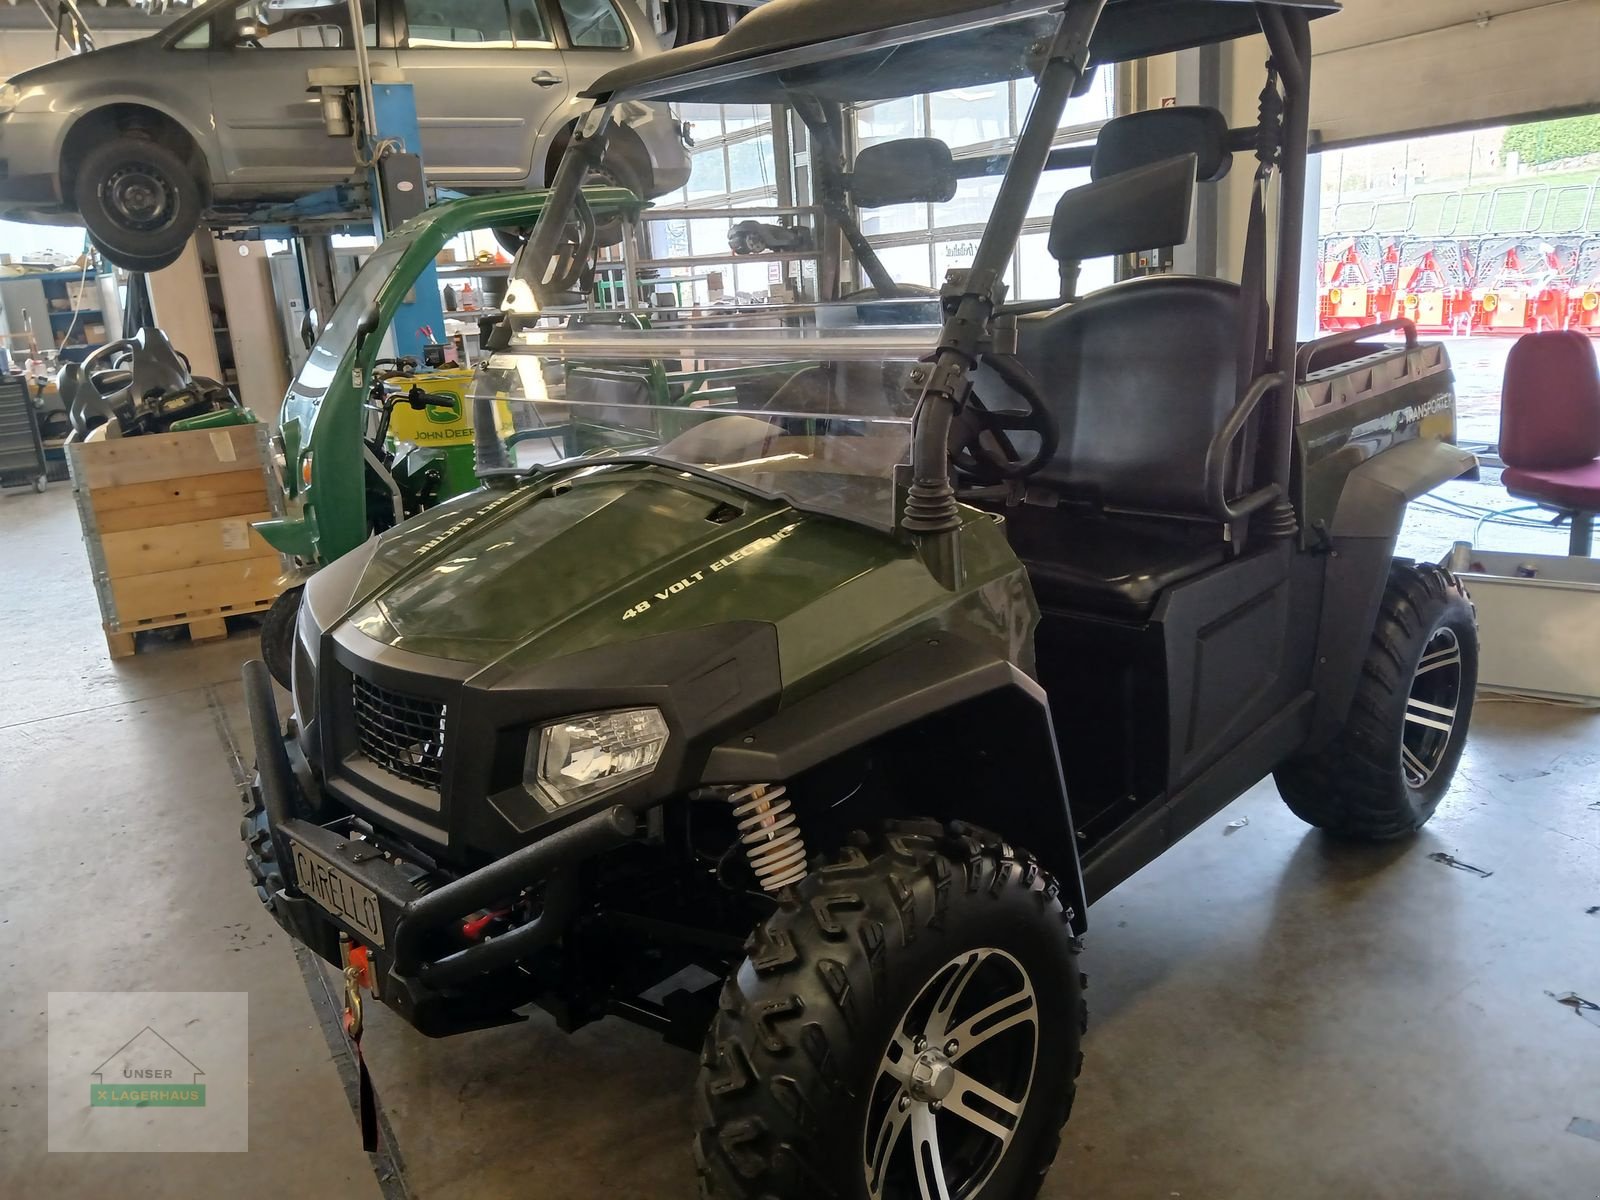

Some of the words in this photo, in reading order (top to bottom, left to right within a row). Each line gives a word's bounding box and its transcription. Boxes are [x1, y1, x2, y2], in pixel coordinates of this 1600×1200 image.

[415, 431, 443, 440] JOHN
[413, 517, 475, 555] ELECTRIC
[622, 600, 651, 620] 48
[654, 570, 705, 600] VOLT
[709, 527, 793, 572] ELECTRIC
[298, 852, 377, 935] CARELLO
